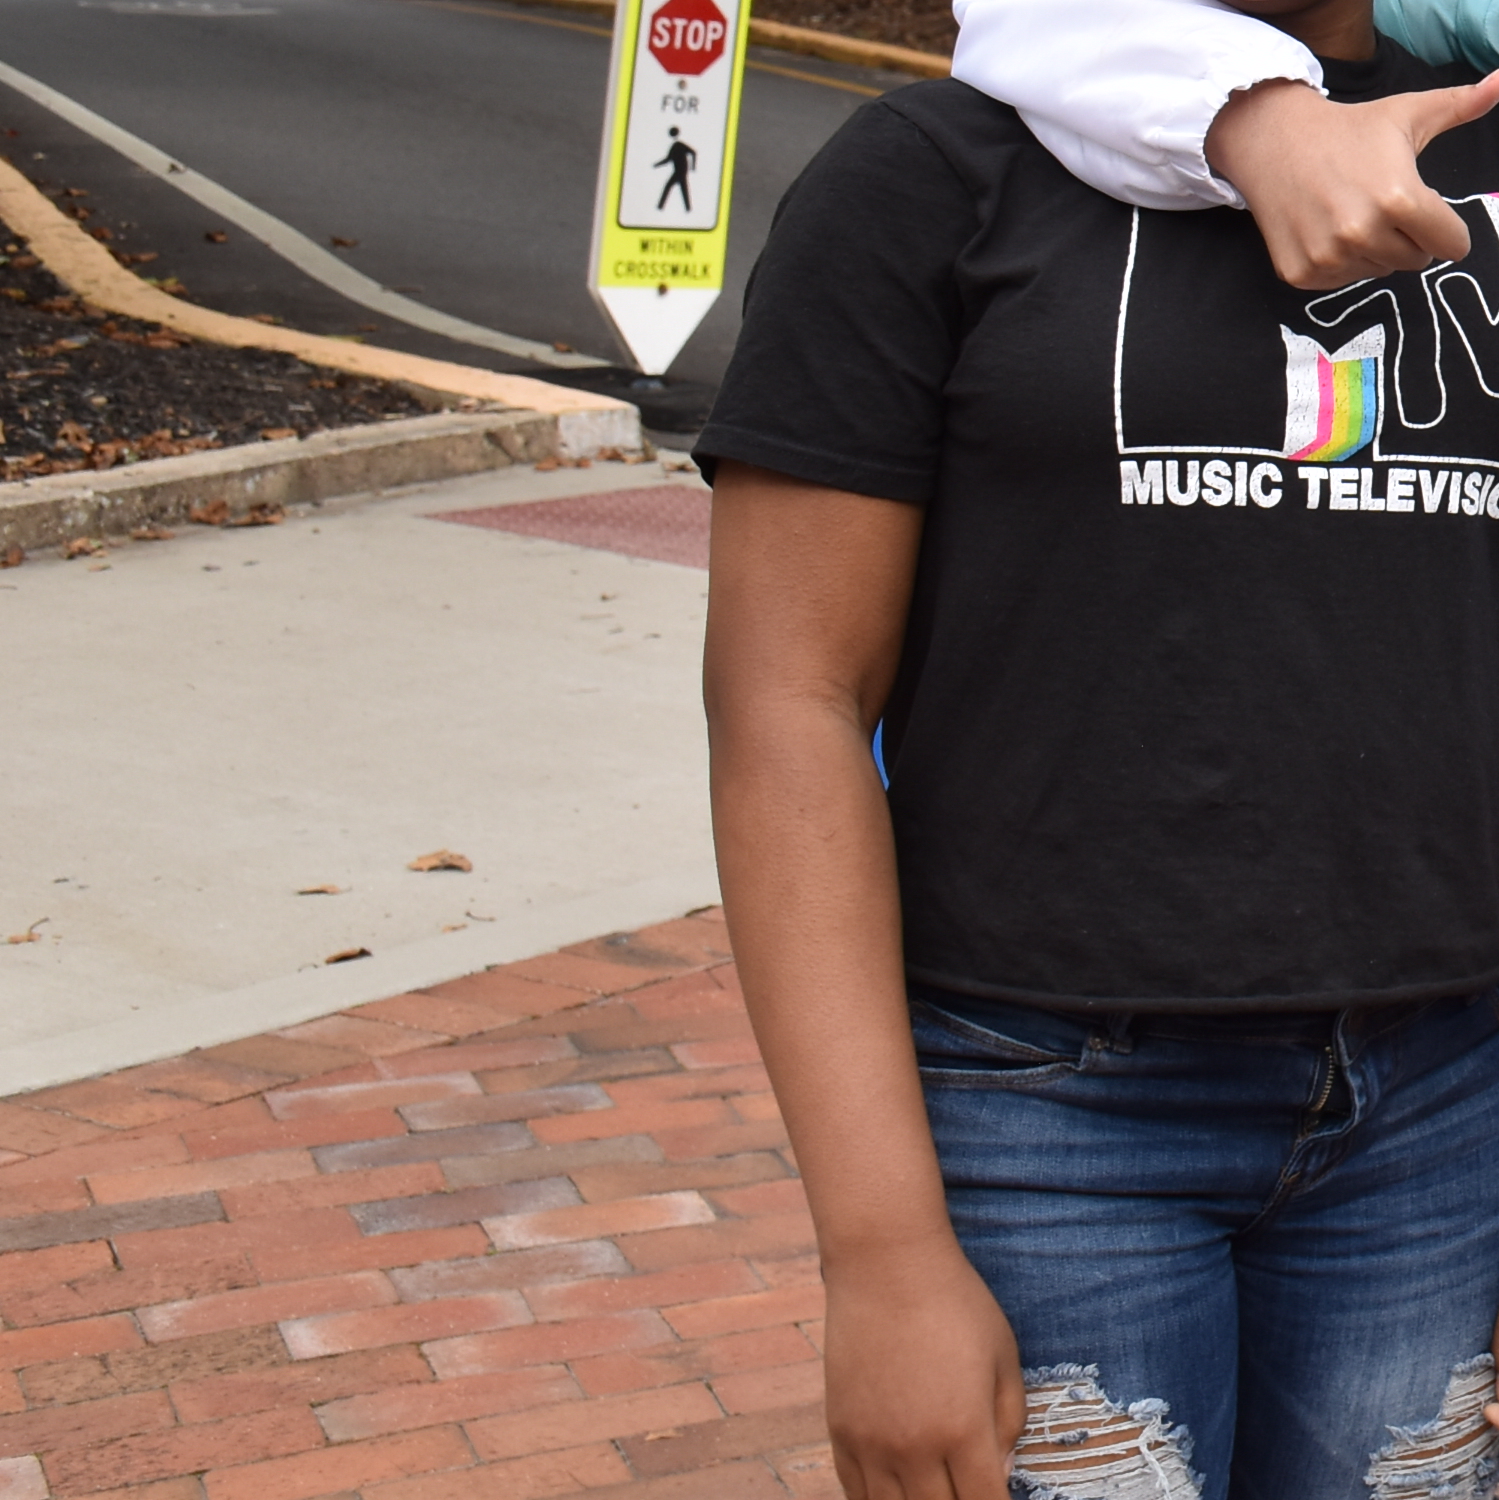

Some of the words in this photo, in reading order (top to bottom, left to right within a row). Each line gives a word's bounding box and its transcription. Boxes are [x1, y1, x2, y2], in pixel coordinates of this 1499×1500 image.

[652, 17, 724, 52] STOP
[660, 94, 700, 113] FOR
[639, 239, 694, 255] WITHIN
[614, 260, 711, 280] CROSSWALK
[1119, 460, 1283, 509] MUSIC
